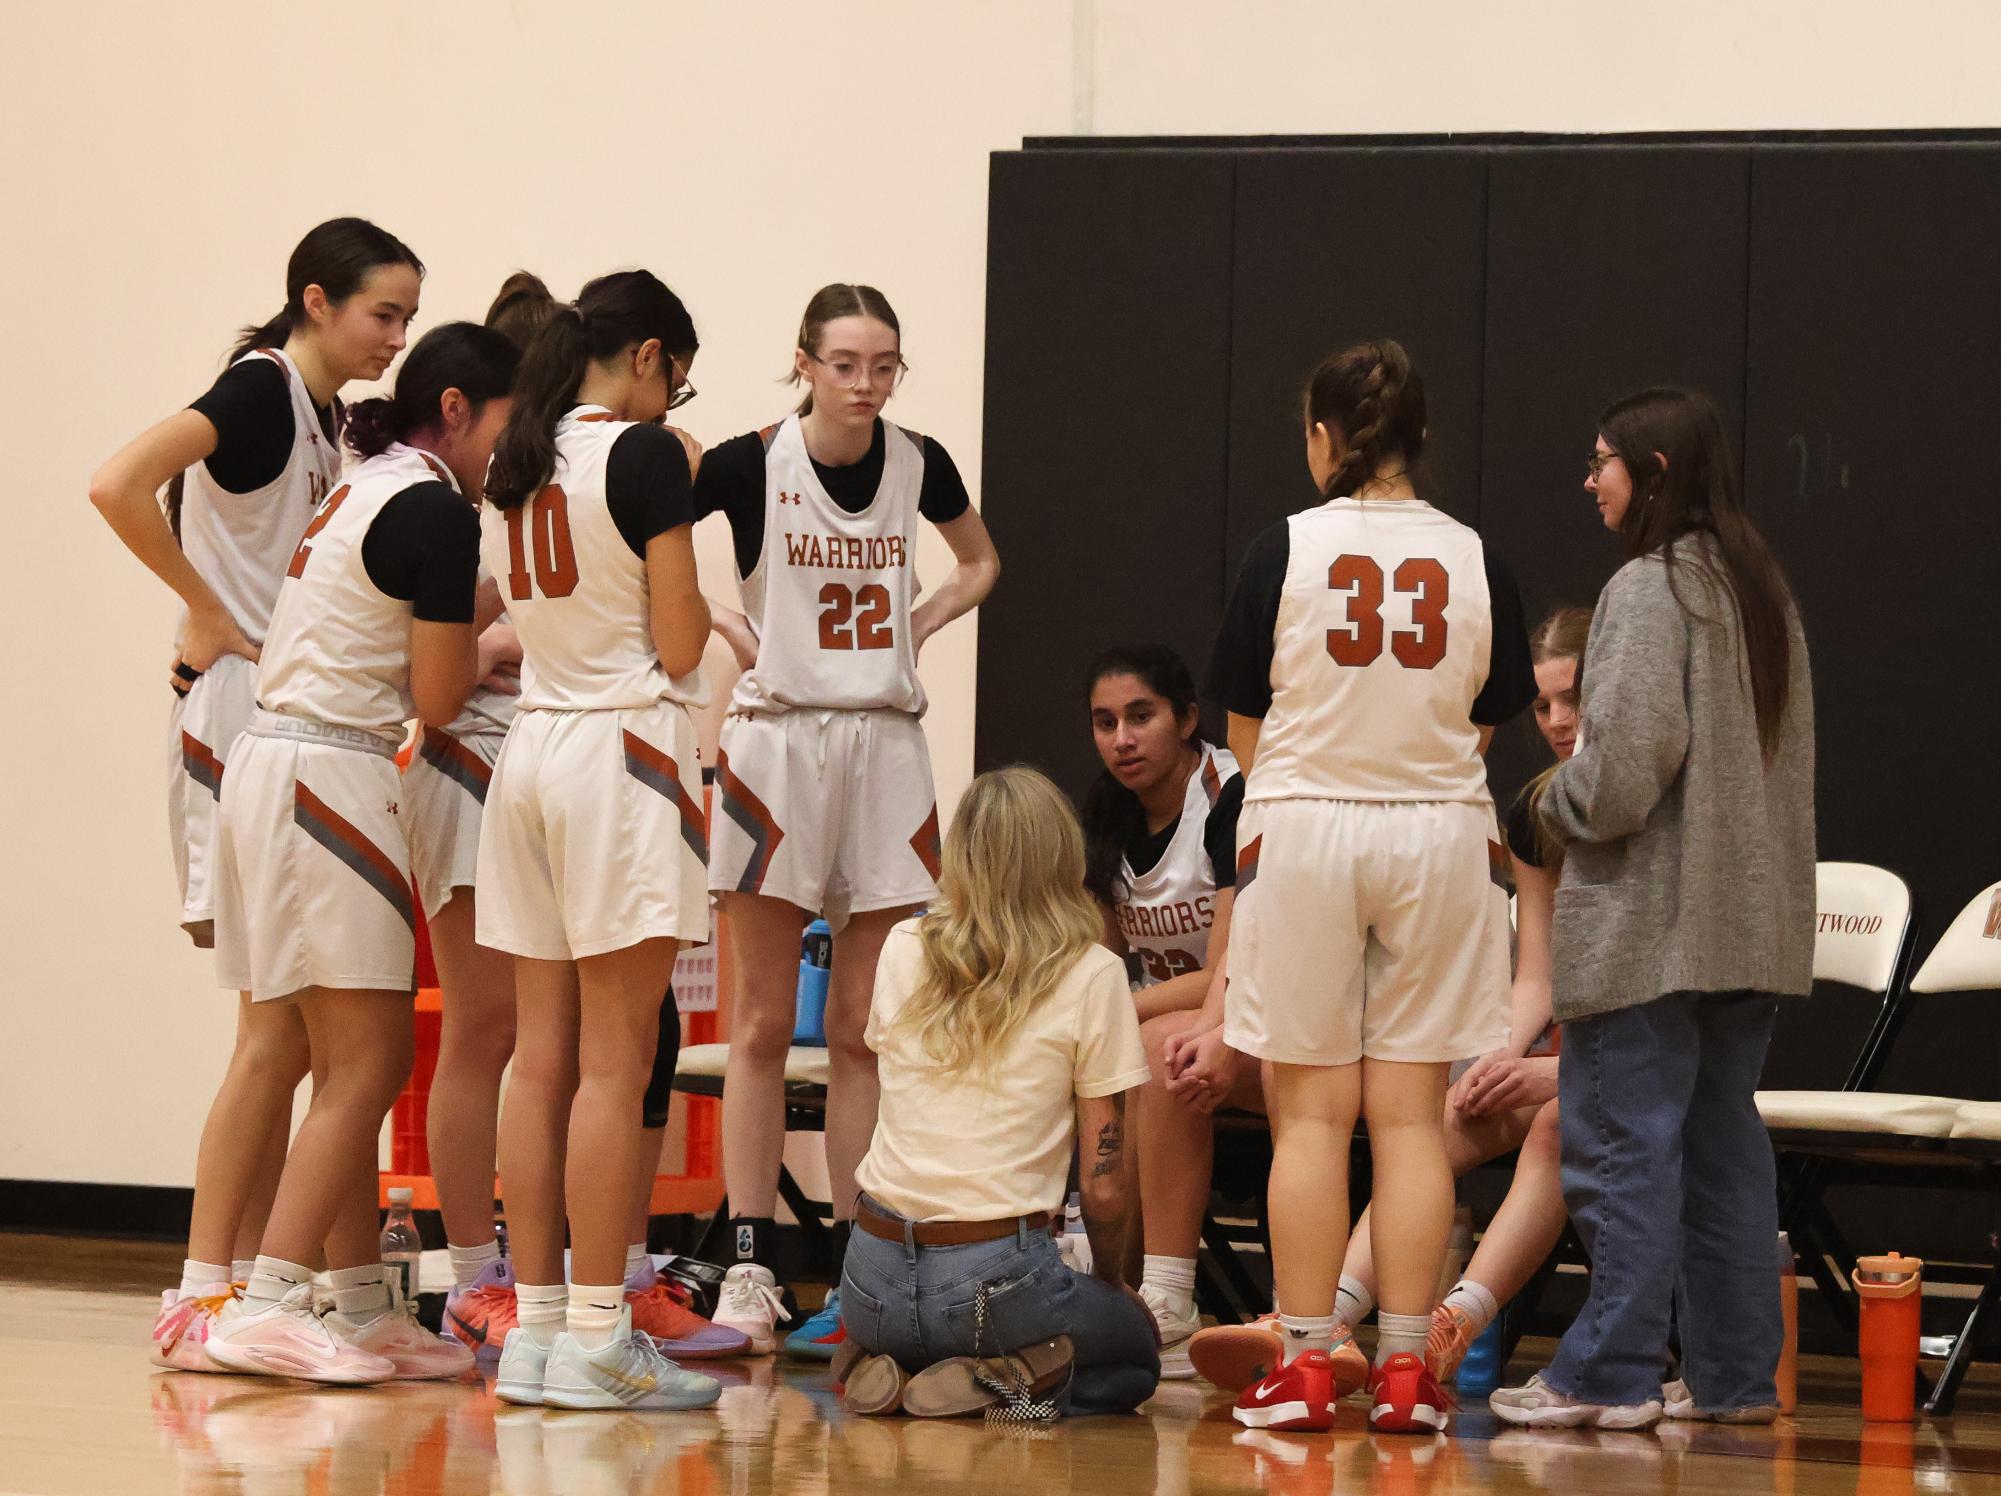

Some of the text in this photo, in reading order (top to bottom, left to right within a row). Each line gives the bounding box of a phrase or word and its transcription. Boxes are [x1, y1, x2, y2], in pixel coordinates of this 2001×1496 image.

[287, 484, 352, 579] 2
[503, 483, 580, 600] 10
[819, 583, 893, 650] 22
[1326, 554, 1449, 669] 33
[1816, 912, 1883, 934] TWOOD
